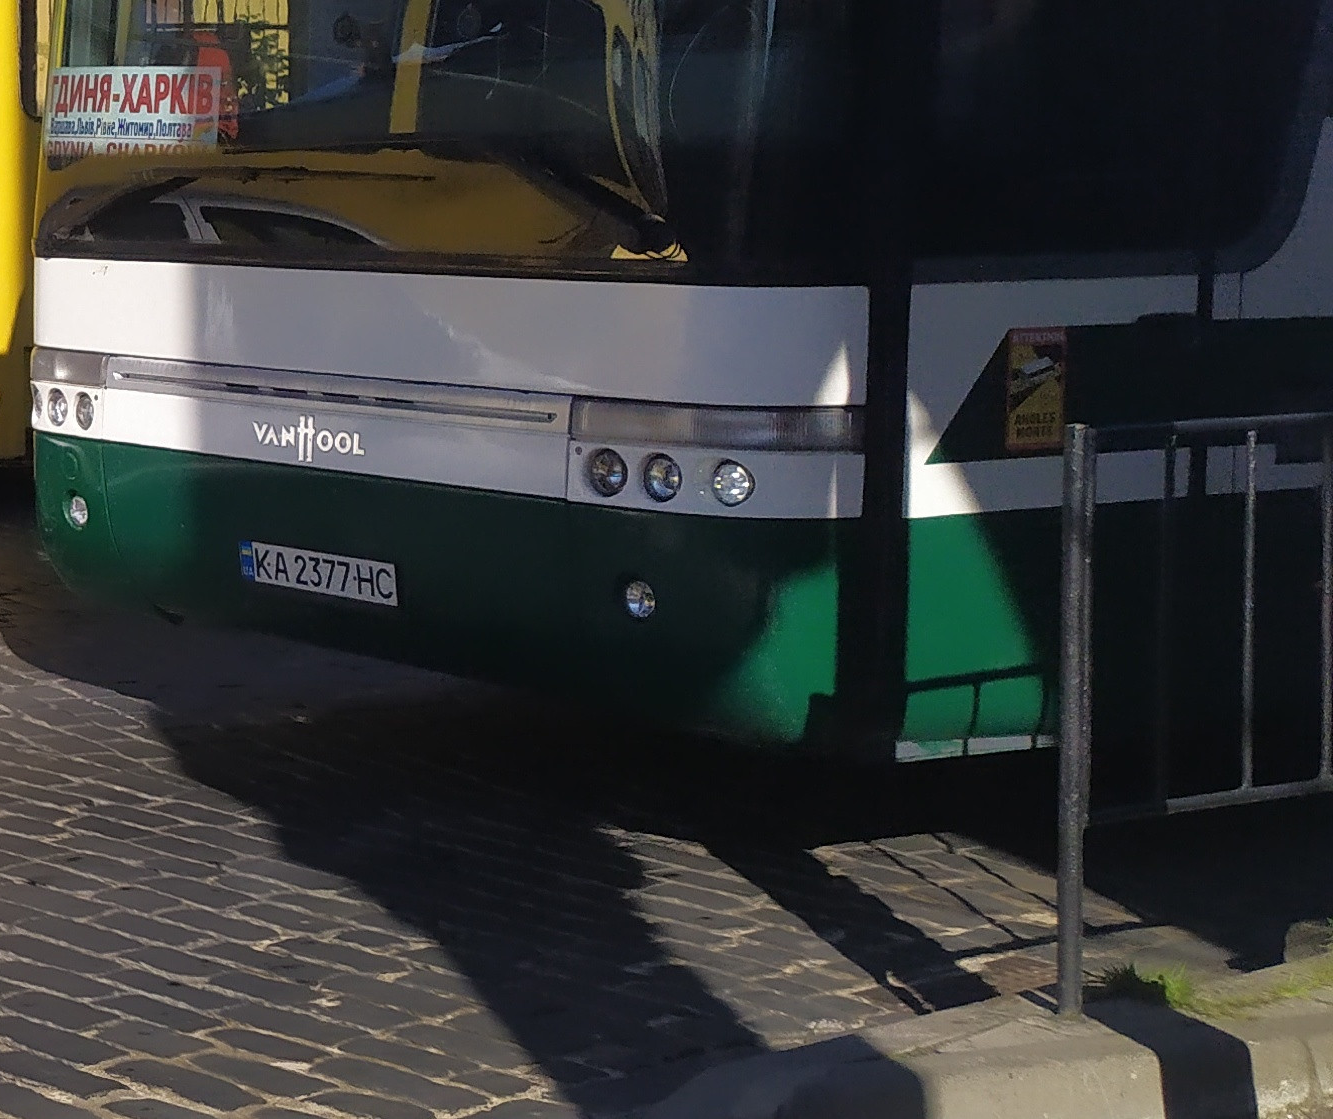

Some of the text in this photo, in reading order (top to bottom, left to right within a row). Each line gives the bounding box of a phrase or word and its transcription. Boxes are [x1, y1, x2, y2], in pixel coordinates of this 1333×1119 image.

[255, 547, 290, 583] KA
[294, 555, 351, 592] 2377
[356, 564, 394, 600] HC
